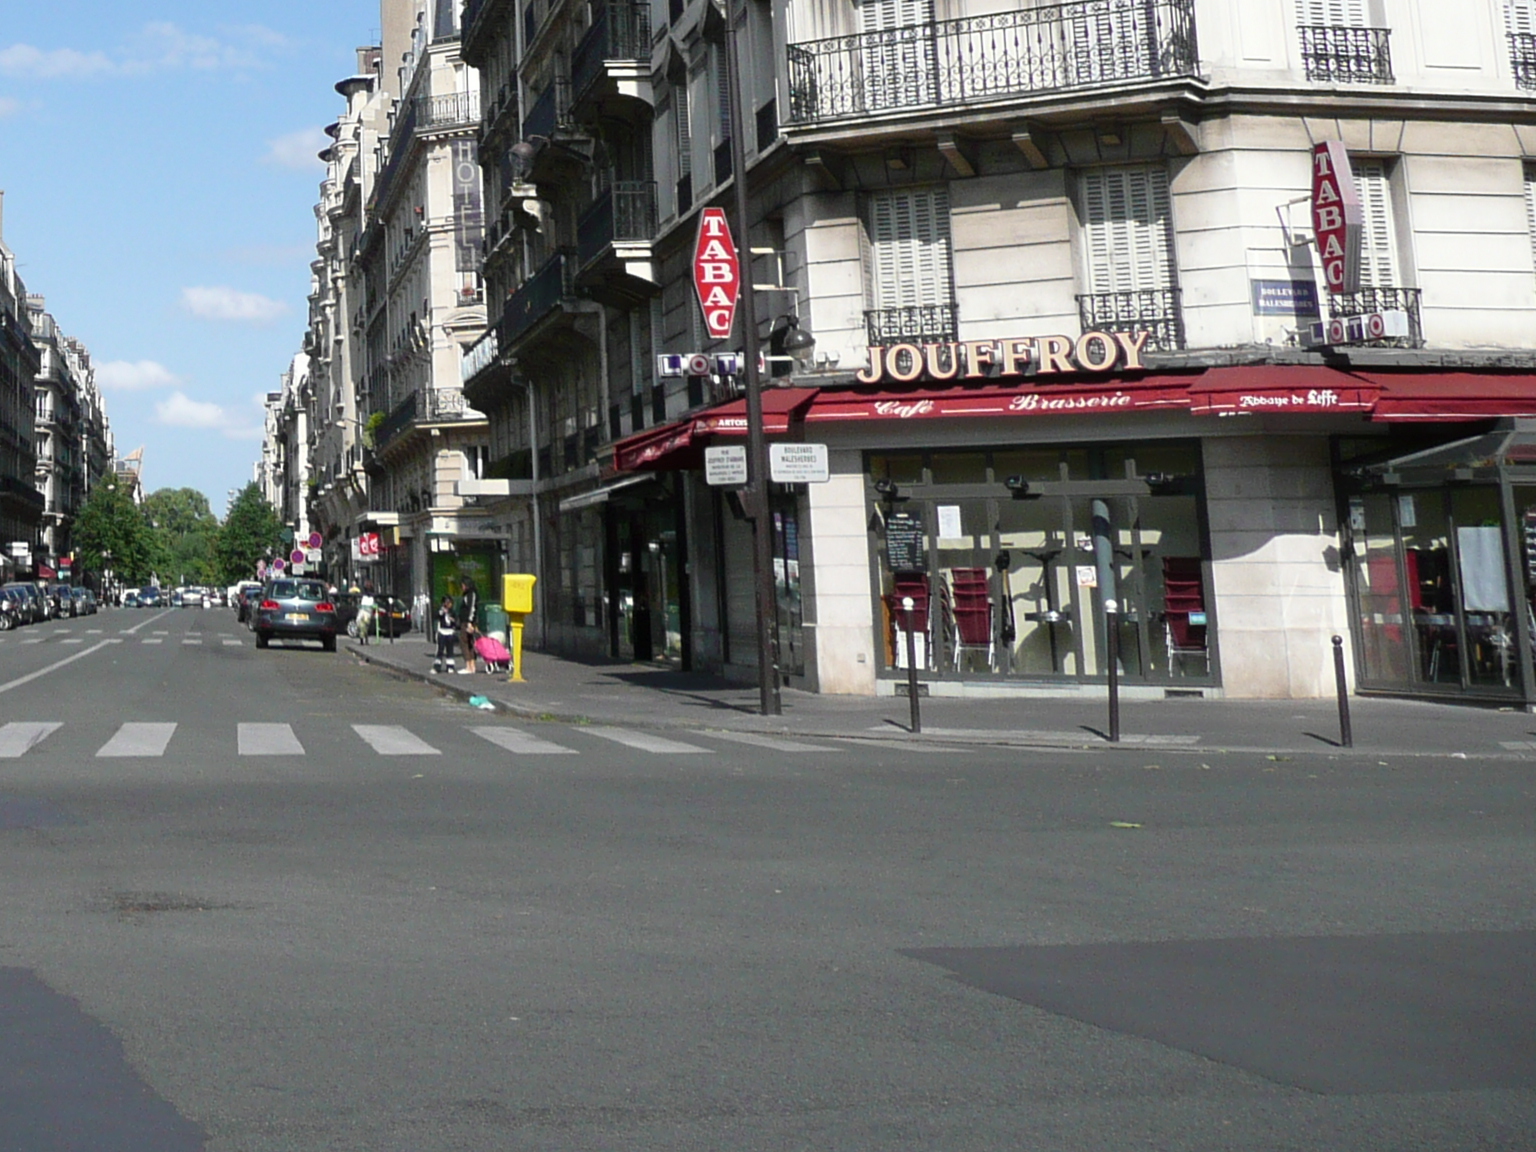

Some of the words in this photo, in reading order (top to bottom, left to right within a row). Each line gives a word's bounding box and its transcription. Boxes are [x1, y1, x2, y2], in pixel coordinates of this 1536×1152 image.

[457, 141, 475, 247] HOTEL
[1314, 152, 1344, 285] TABAC
[699, 216, 734, 330] TABAC
[1260, 288, 1309, 296] BOULEVARD
[1310, 313, 1385, 344] LOTO
[662, 352, 765, 376] LOT
[856, 331, 1148, 384] JOUFFROY
[874, 399, 935, 418] Café
[1009, 392, 1131, 411] Brasserie
[1239, 395, 1289, 407] Abbaye
[1292, 394, 1304, 404] de
[1307, 389, 1338, 407] Leffe
